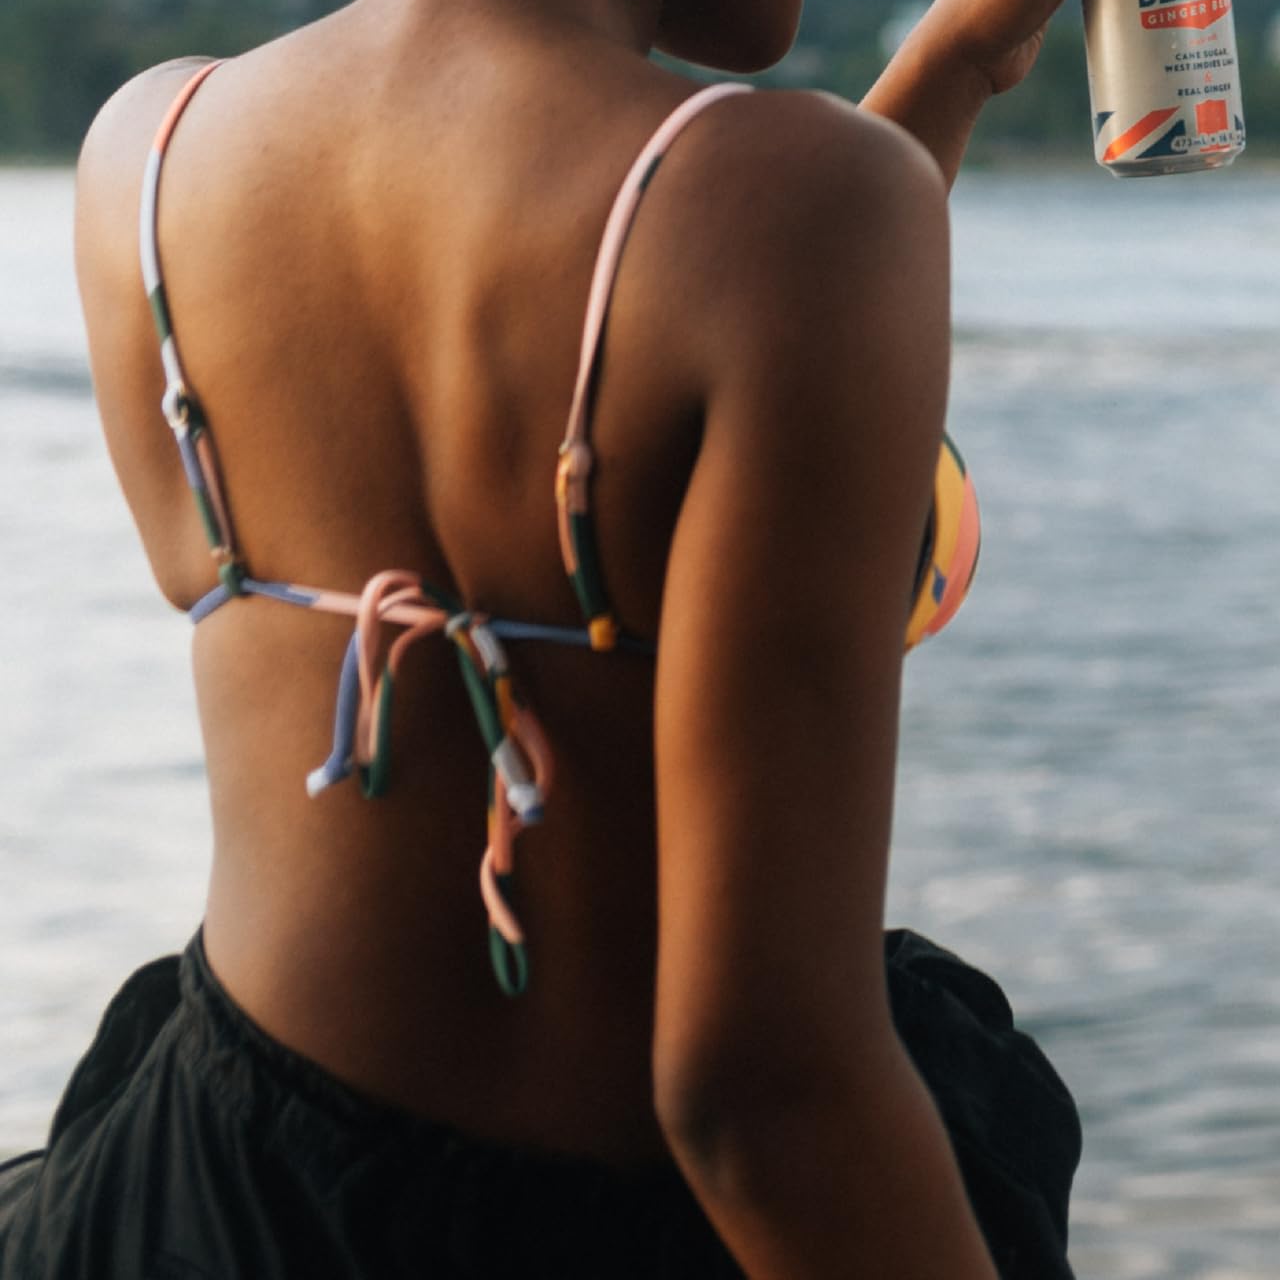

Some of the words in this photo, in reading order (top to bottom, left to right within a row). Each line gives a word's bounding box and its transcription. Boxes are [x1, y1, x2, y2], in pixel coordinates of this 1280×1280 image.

[1148, 3, 1207, 25] GINGER
[1164, 63, 1191, 73] WEST
[1193, 58, 1221, 71] INDIES
[1177, 86, 1201, 97] REAL
